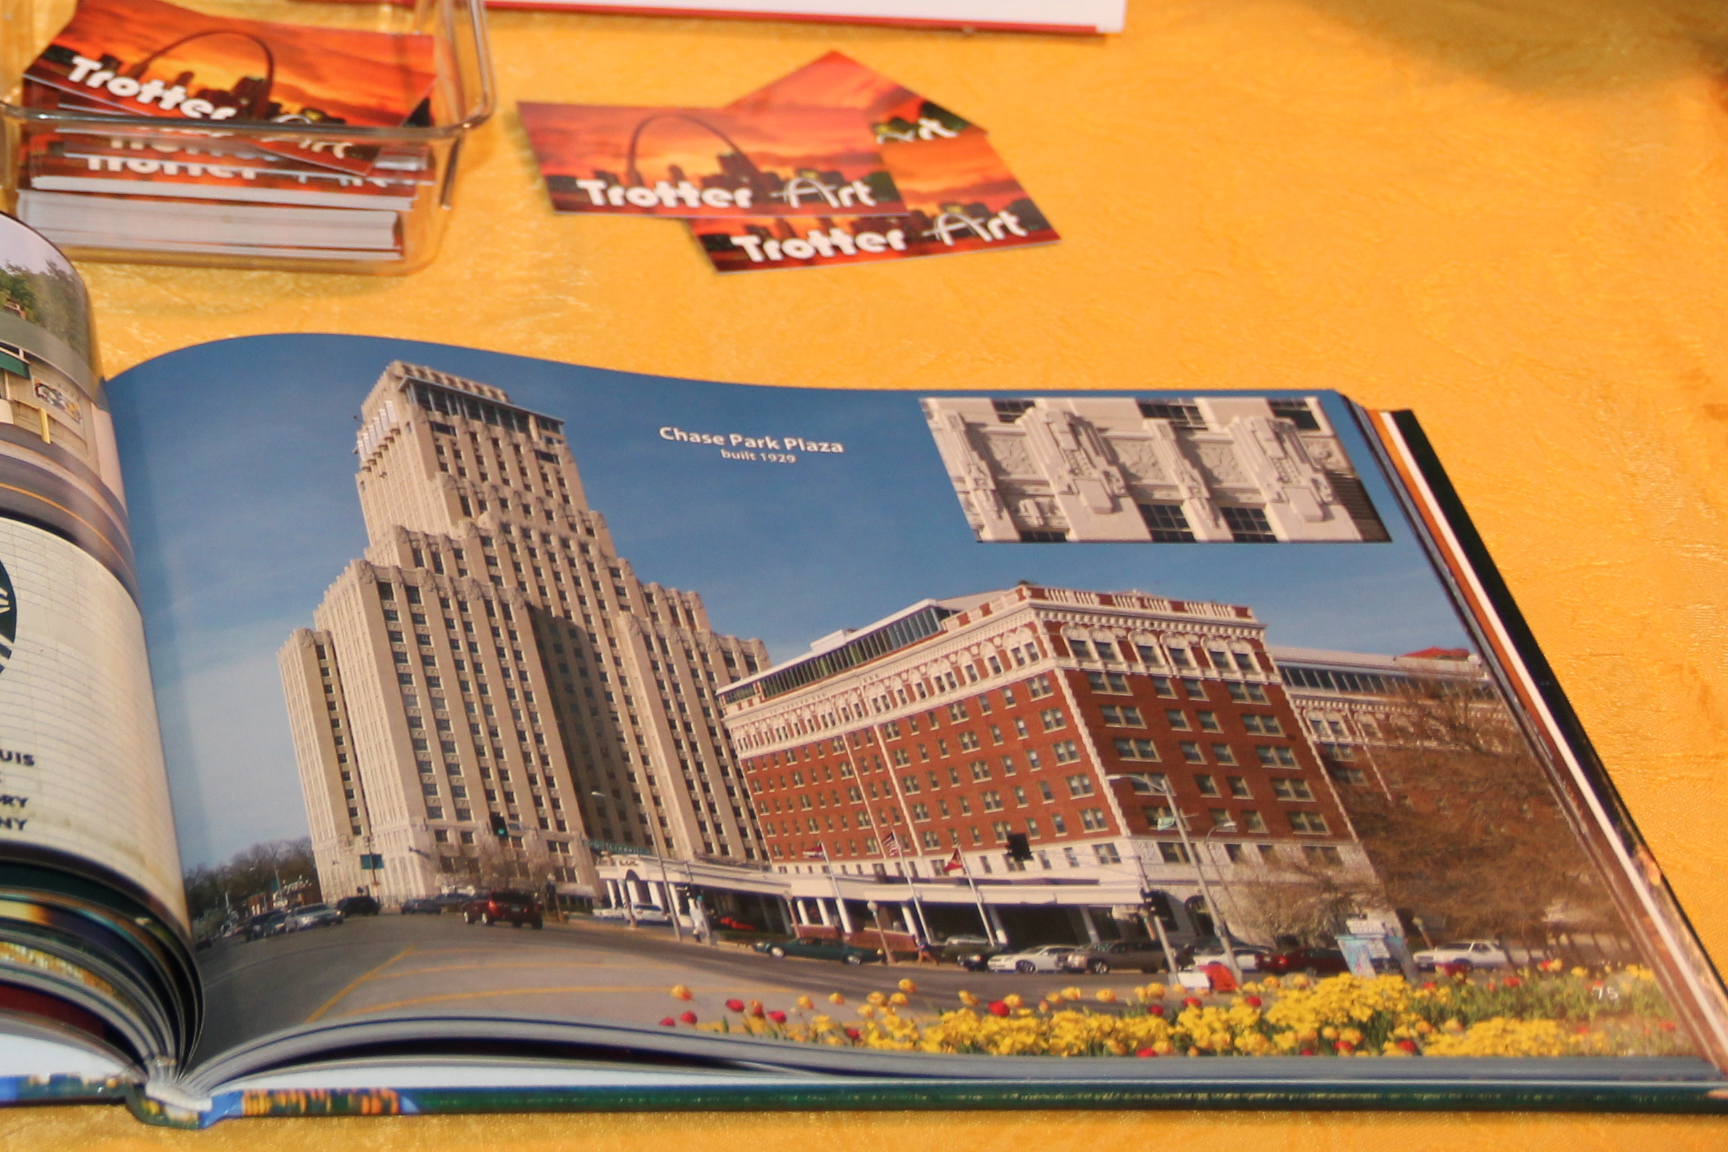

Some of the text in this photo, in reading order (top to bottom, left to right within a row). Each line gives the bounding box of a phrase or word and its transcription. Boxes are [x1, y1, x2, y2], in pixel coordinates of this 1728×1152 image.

[68, 56, 237, 121] Trotter
[576, 177, 876, 209] Trotter Art
[730, 212, 1028, 263] Trotter Art
[659, 427, 844, 455] Chase Park Plaza
[721, 449, 797, 464] built 1929
